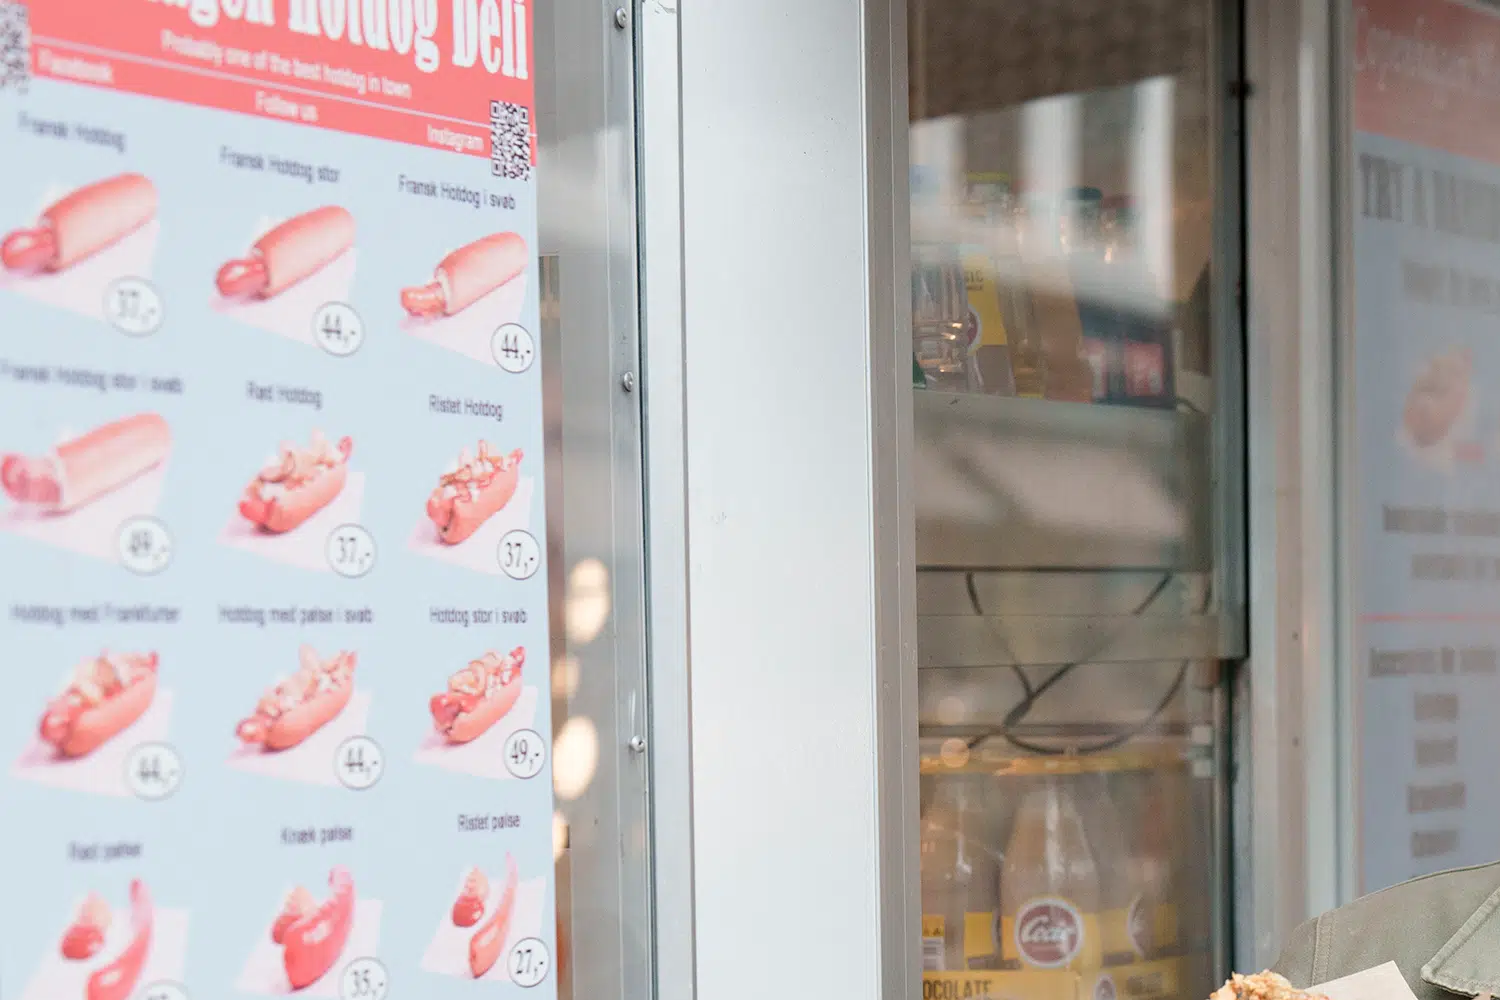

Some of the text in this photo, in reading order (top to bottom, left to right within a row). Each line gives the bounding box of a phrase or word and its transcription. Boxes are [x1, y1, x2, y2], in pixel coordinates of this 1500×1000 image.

[453, 0, 529, 80] Deli
[161, 29, 221, 66] Probably
[270, 54, 290, 75] the
[294, 58, 321, 80] best
[324, 64, 365, 94] hotdog
[368, 72, 380, 92] in
[383, 76, 411, 98] town
[427, 124, 484, 152] Instagram
[219, 146, 264, 170] Fransk
[268, 156, 313, 184] Hotdog
[399, 174, 436, 197] Fransk
[441, 182, 481, 209] Hotdog
[320, 314, 357, 343] 44,-
[500, 333, 532, 363] 44,-
[277, 384, 323, 411] Hotdog
[429, 394, 504, 422] Ristet Hotdog
[336, 536, 371, 567] 37,-
[504, 541, 535, 570] 37,-
[218, 603, 266, 628] Hotdog
[269, 604, 297, 623] med
[430, 605, 469, 627] Hotdog
[472, 607, 494, 624] stor
[344, 752, 379, 781] 44,-
[510, 739, 540, 769] 49,-
[457, 812, 489, 832] Ristet
[514, 948, 545, 979] 27,-
[350, 969, 384, 999] 35,-
